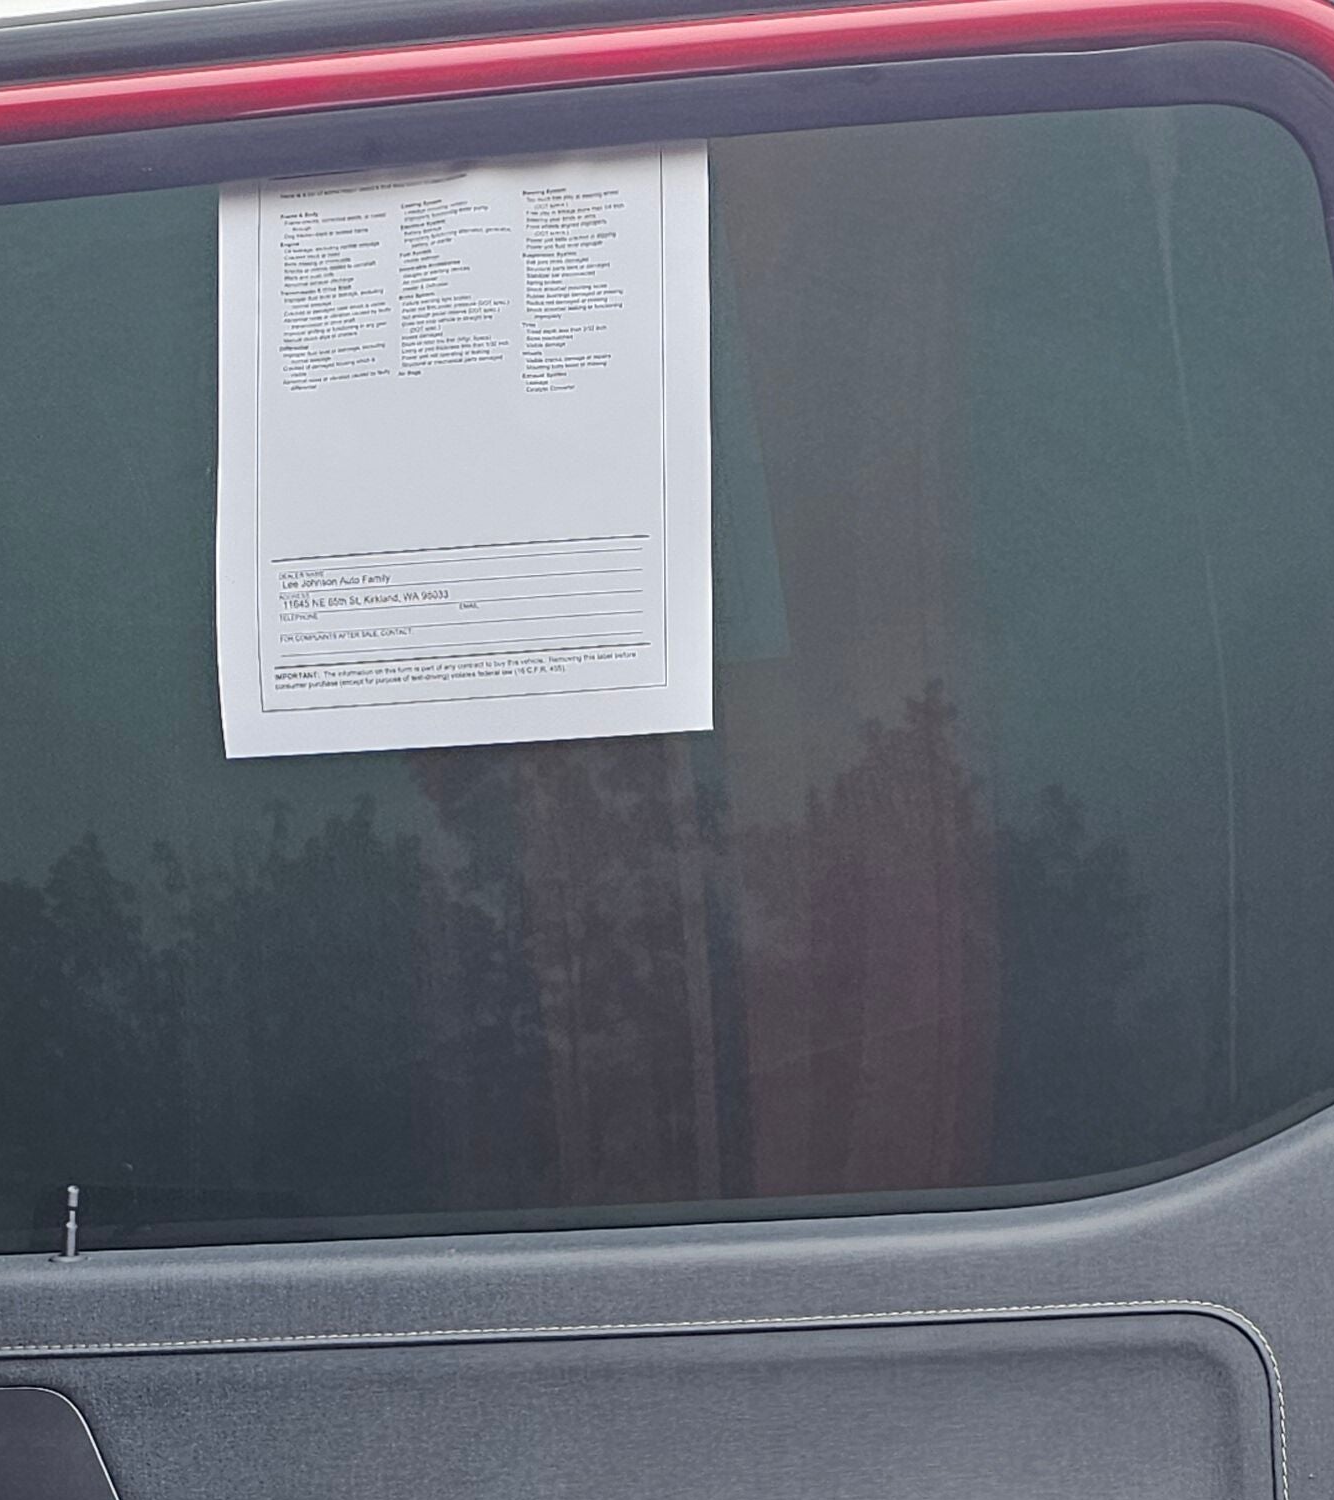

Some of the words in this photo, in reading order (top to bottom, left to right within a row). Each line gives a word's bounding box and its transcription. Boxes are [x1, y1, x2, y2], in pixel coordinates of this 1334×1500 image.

[282, 580, 299, 590] Lee
[300, 578, 337, 589] Johnson
[339, 576, 360, 586] Auto
[362, 573, 391, 585] Family
